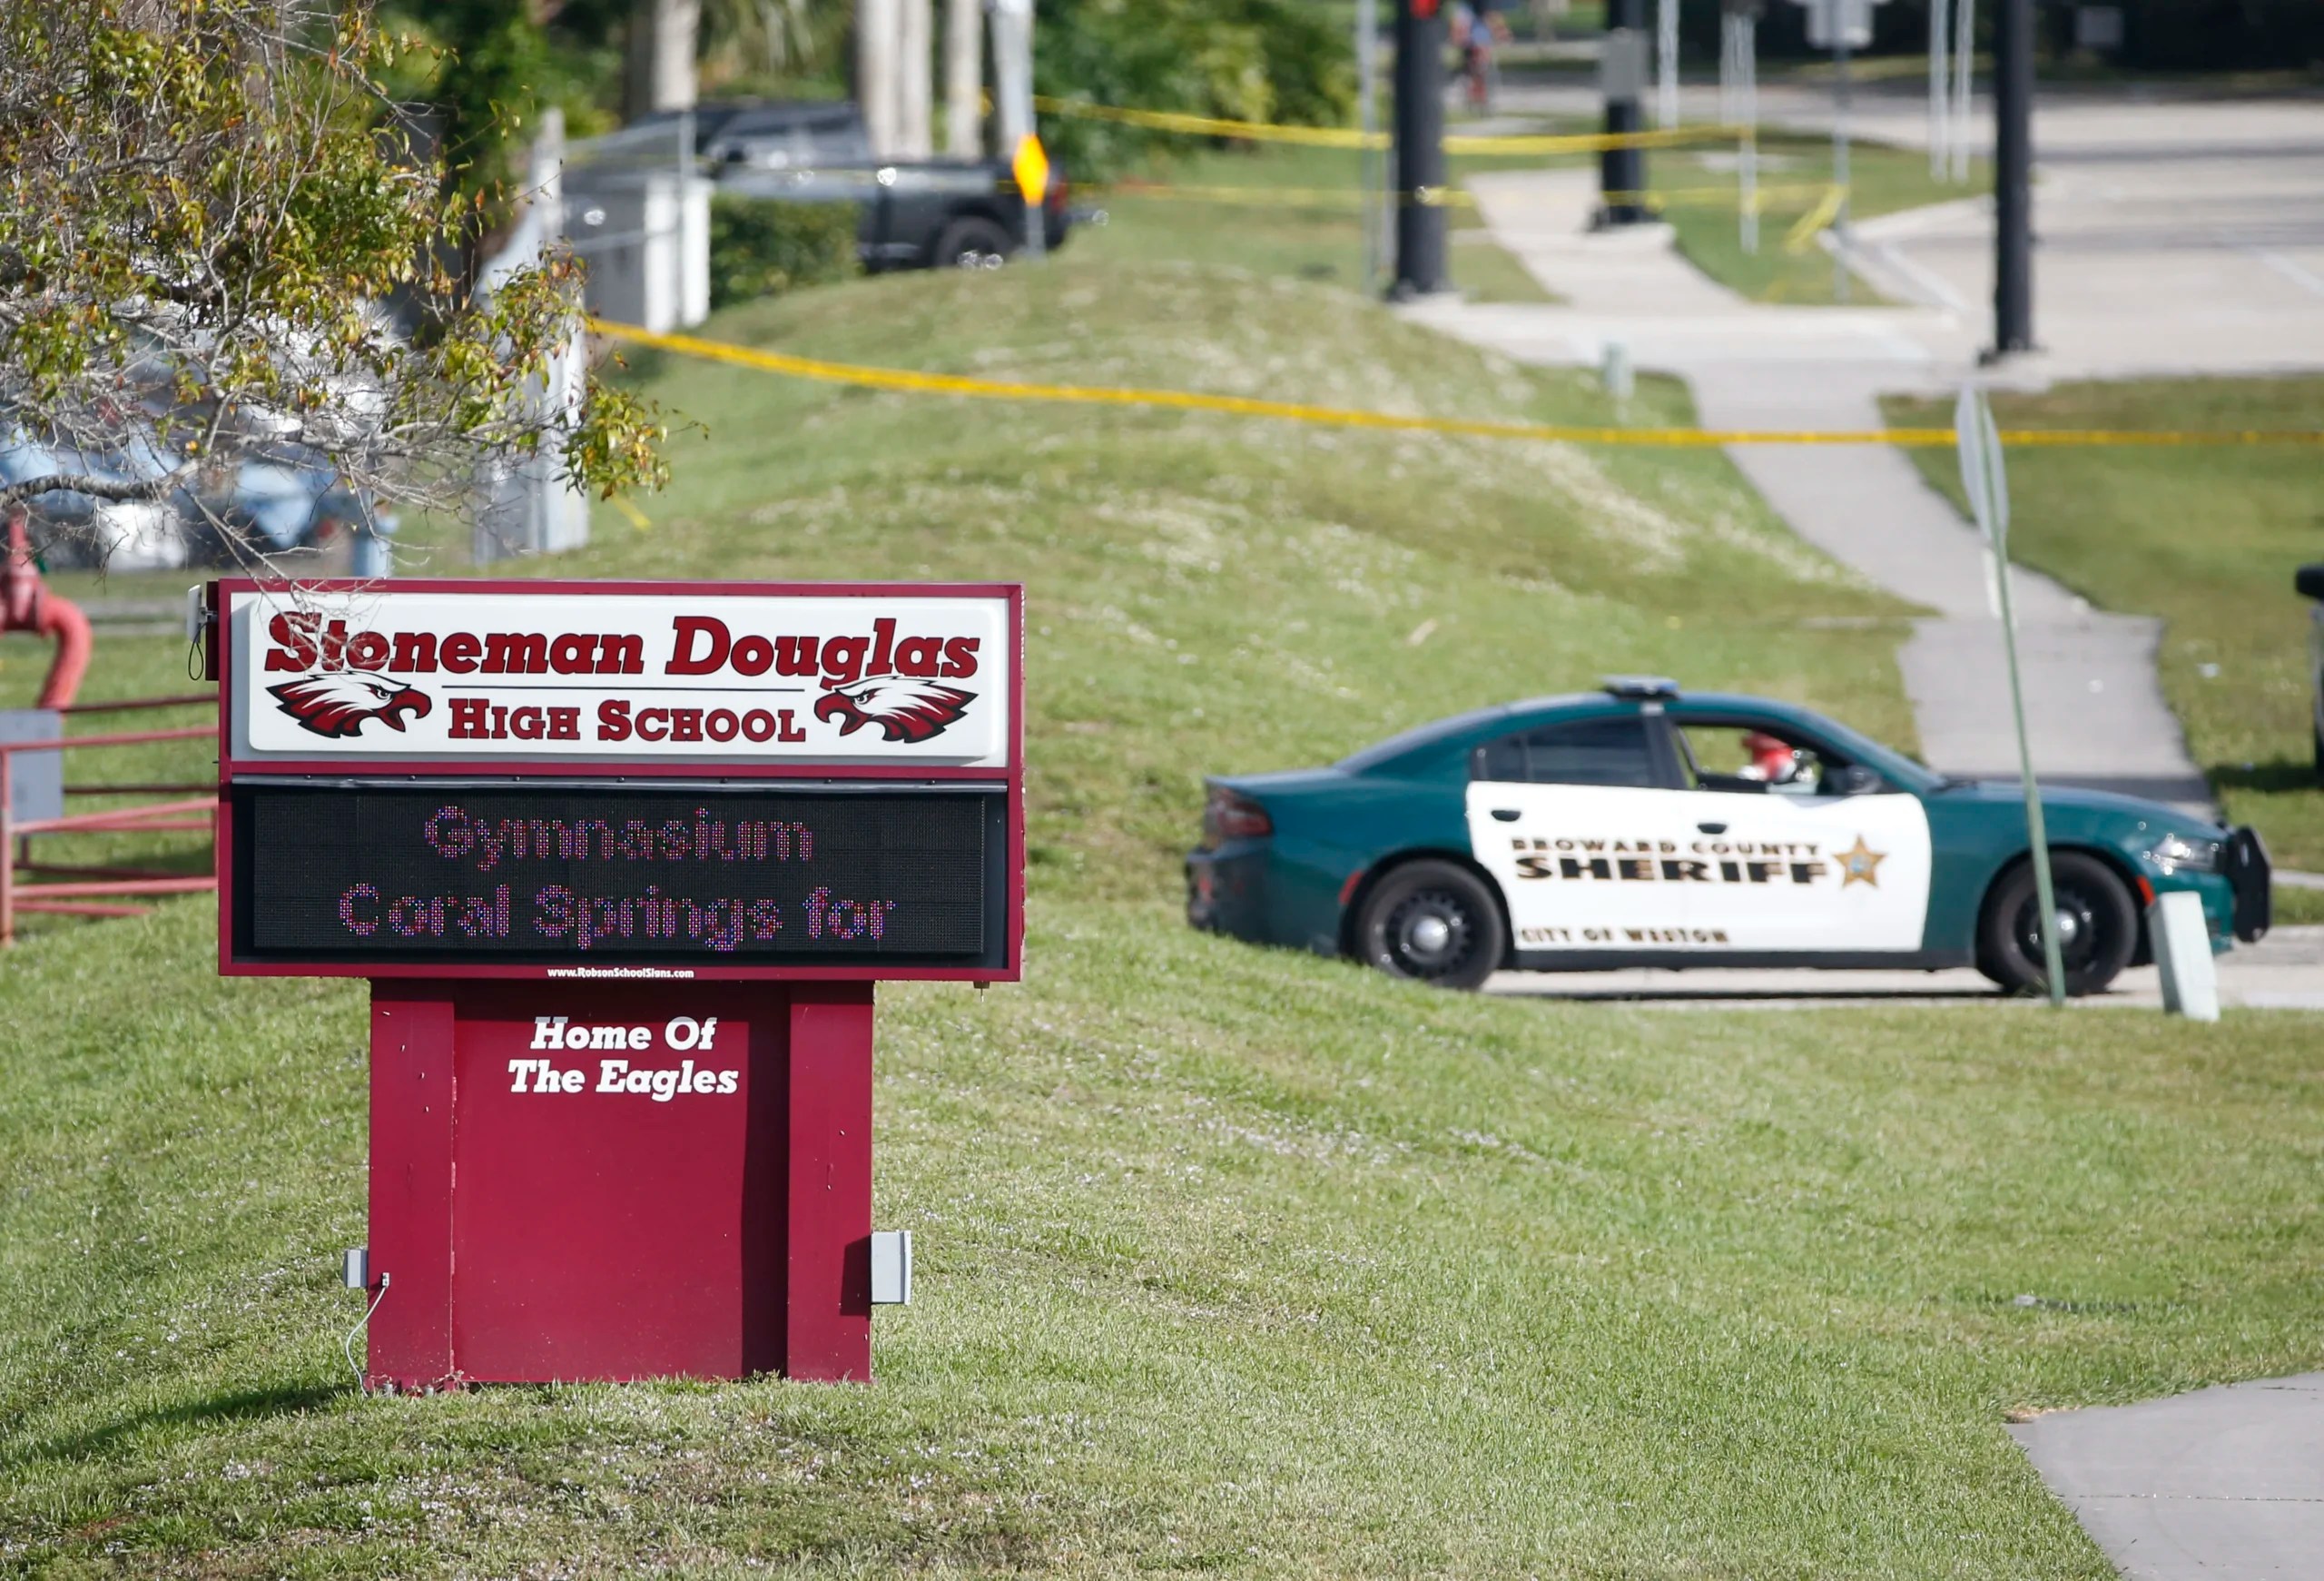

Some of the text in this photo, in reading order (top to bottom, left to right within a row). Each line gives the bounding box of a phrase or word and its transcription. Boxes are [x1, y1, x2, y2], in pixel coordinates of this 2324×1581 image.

[263, 611, 980, 690] Stoneman Douglas
[423, 805, 814, 871] Gymnasium
[1511, 837, 1821, 856] BROWARD COUNTY
[1515, 856, 1828, 884] SHERIFF
[339, 882, 896, 951] Coral Springs for
[1520, 927, 1572, 944] CITY
[1583, 927, 1615, 942] OF
[547, 966, 694, 979] www.RobsonSchoolSigns.com
[529, 1015, 718, 1051] Home Of
[507, 1058, 739, 1102] The Eagles
